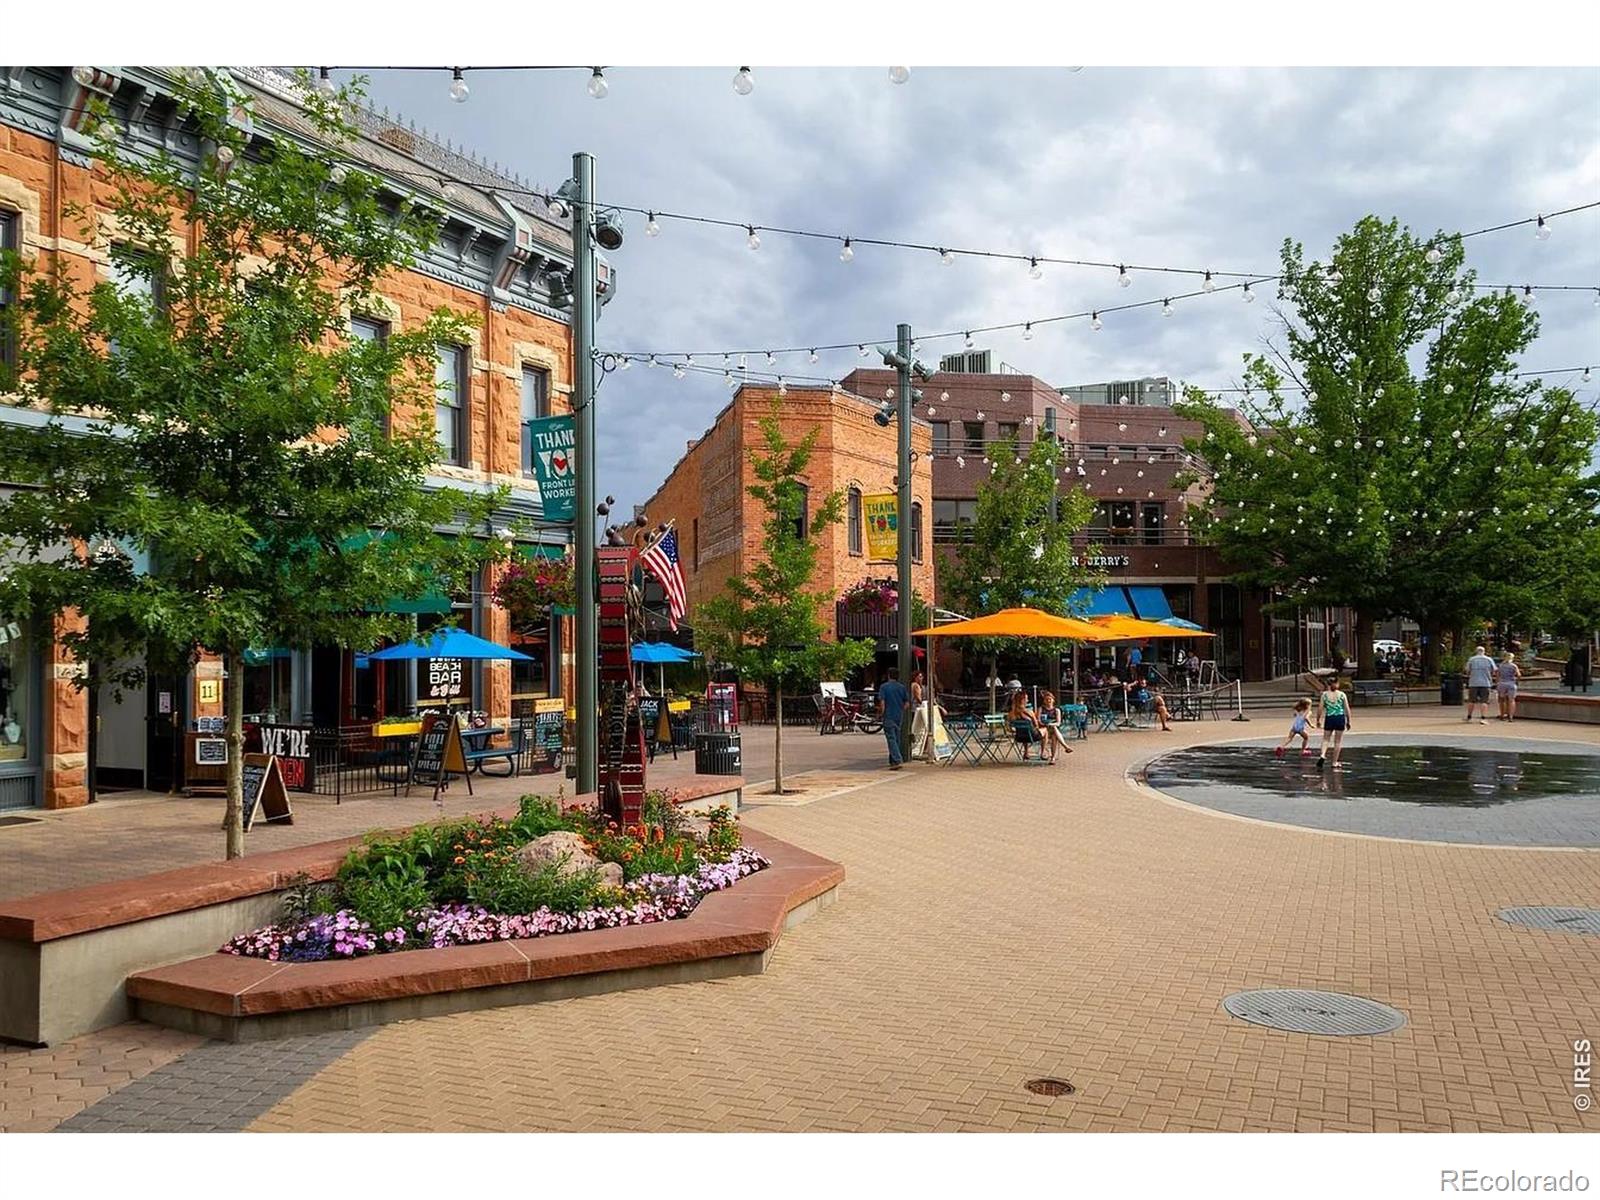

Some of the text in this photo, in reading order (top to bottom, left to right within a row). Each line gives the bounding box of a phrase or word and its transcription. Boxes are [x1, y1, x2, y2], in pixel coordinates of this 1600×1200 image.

[542, 480, 567, 490] FRONT
[543, 487, 575, 499] WORKE
[1087, 555, 1129, 566] JERRY'S
[430, 671, 461, 684] BAR
[202, 685, 213, 698] 11
[640, 700, 659, 708] JACK
[261, 727, 310, 758] WE'RE
